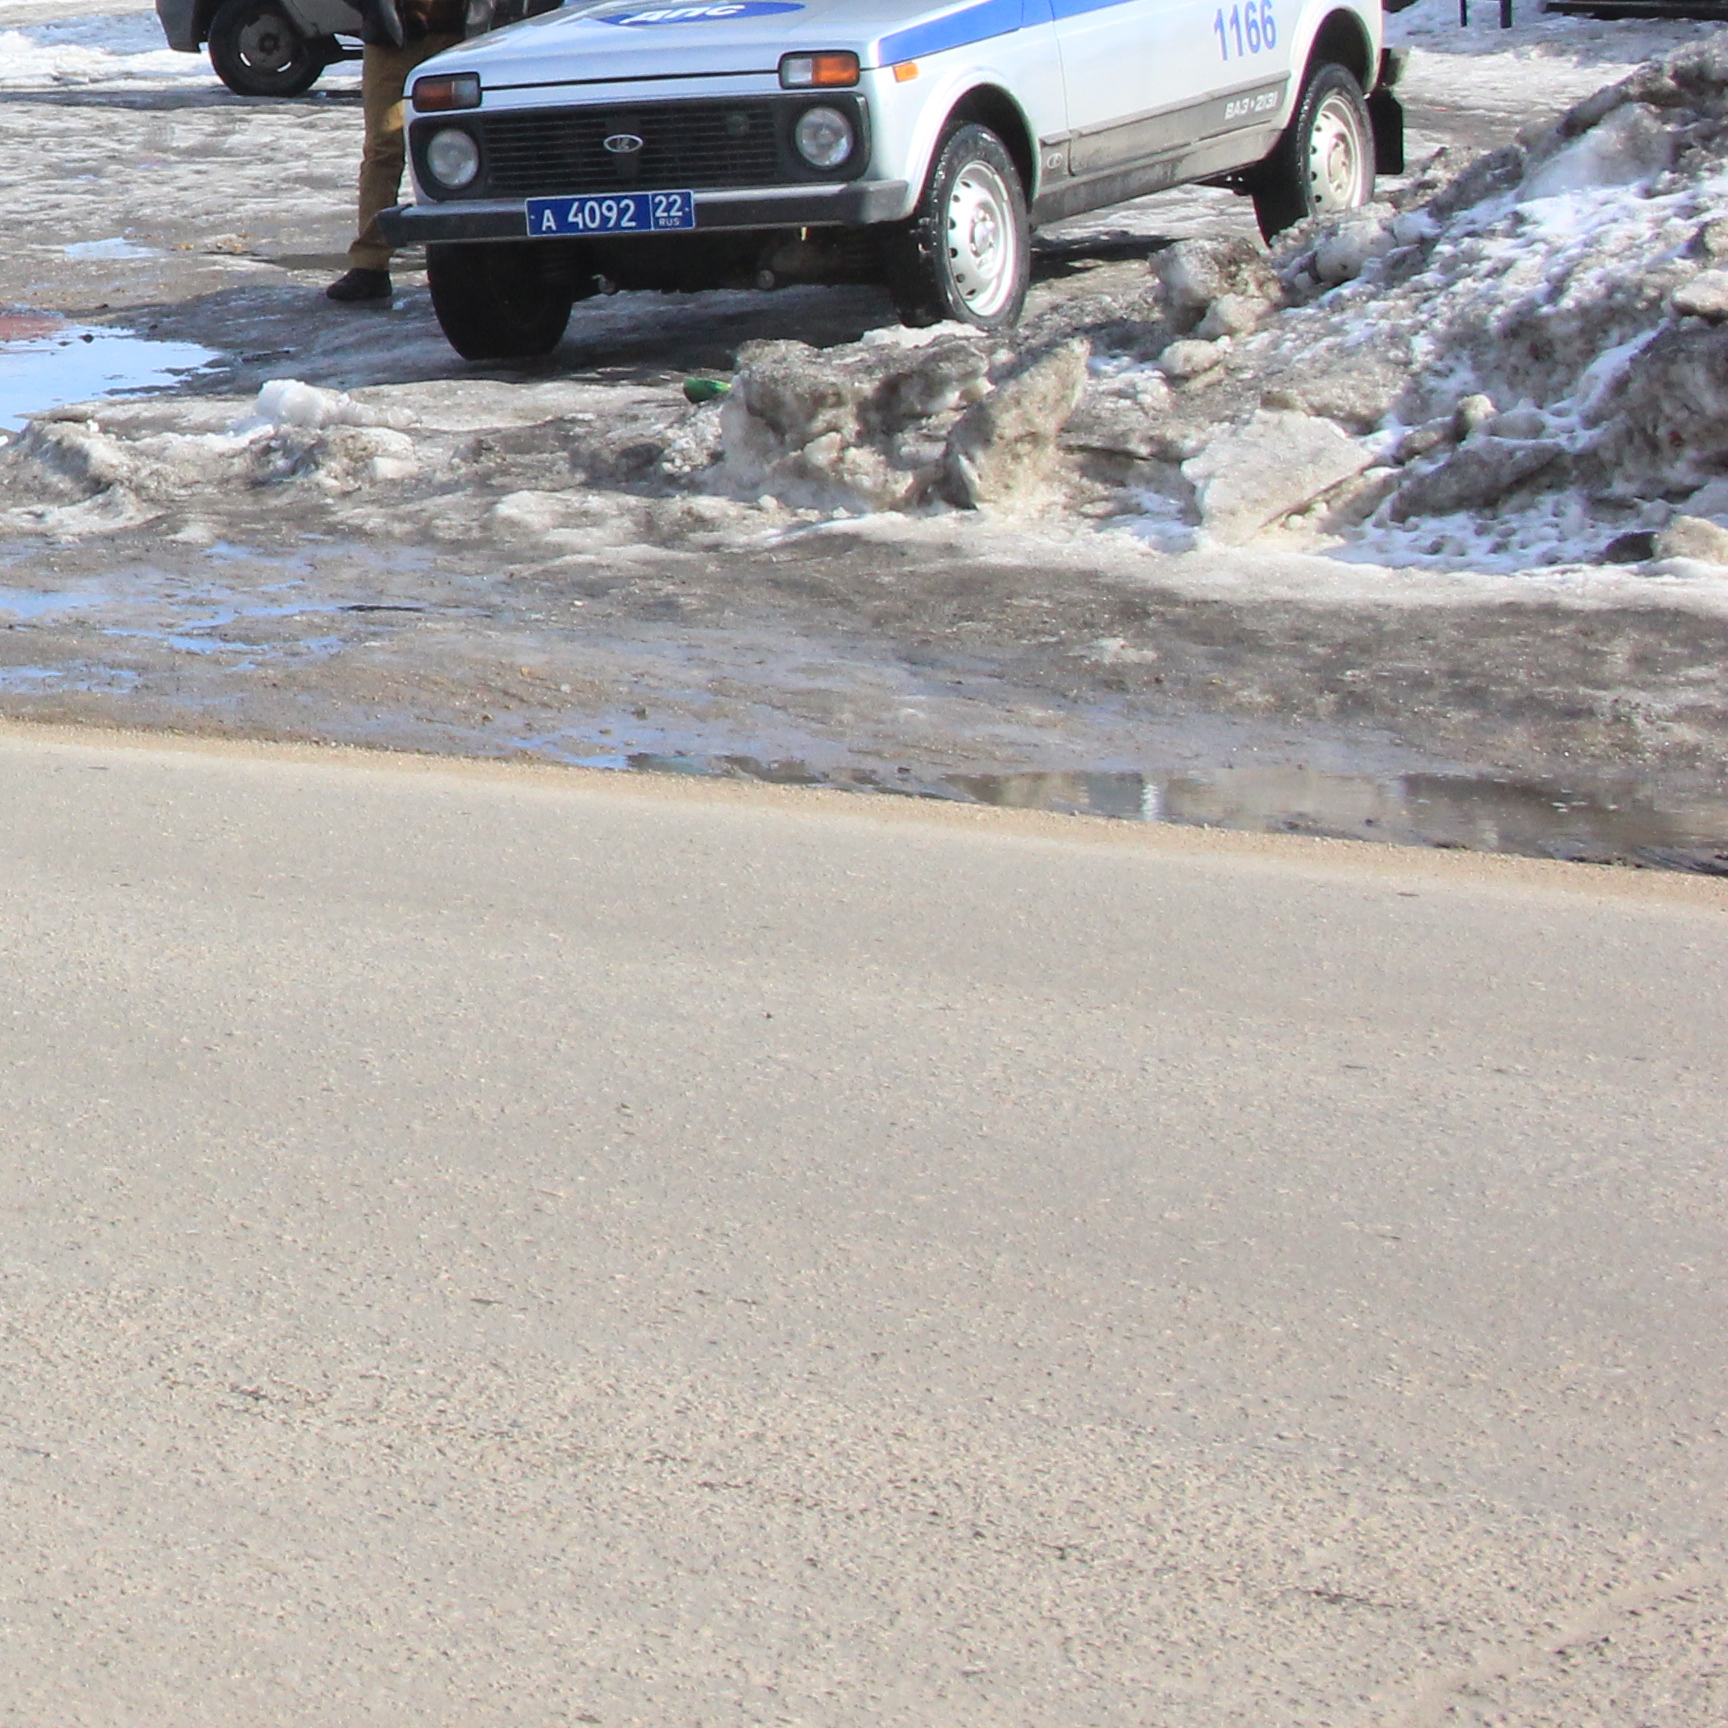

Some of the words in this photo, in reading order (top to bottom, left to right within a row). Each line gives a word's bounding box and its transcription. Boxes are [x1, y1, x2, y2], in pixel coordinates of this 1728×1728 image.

[619, 4, 746, 24] ДПС
[567, 198, 637, 230] 4092
[653, 194, 683, 218] 22
[658, 217, 681, 227] RUS
